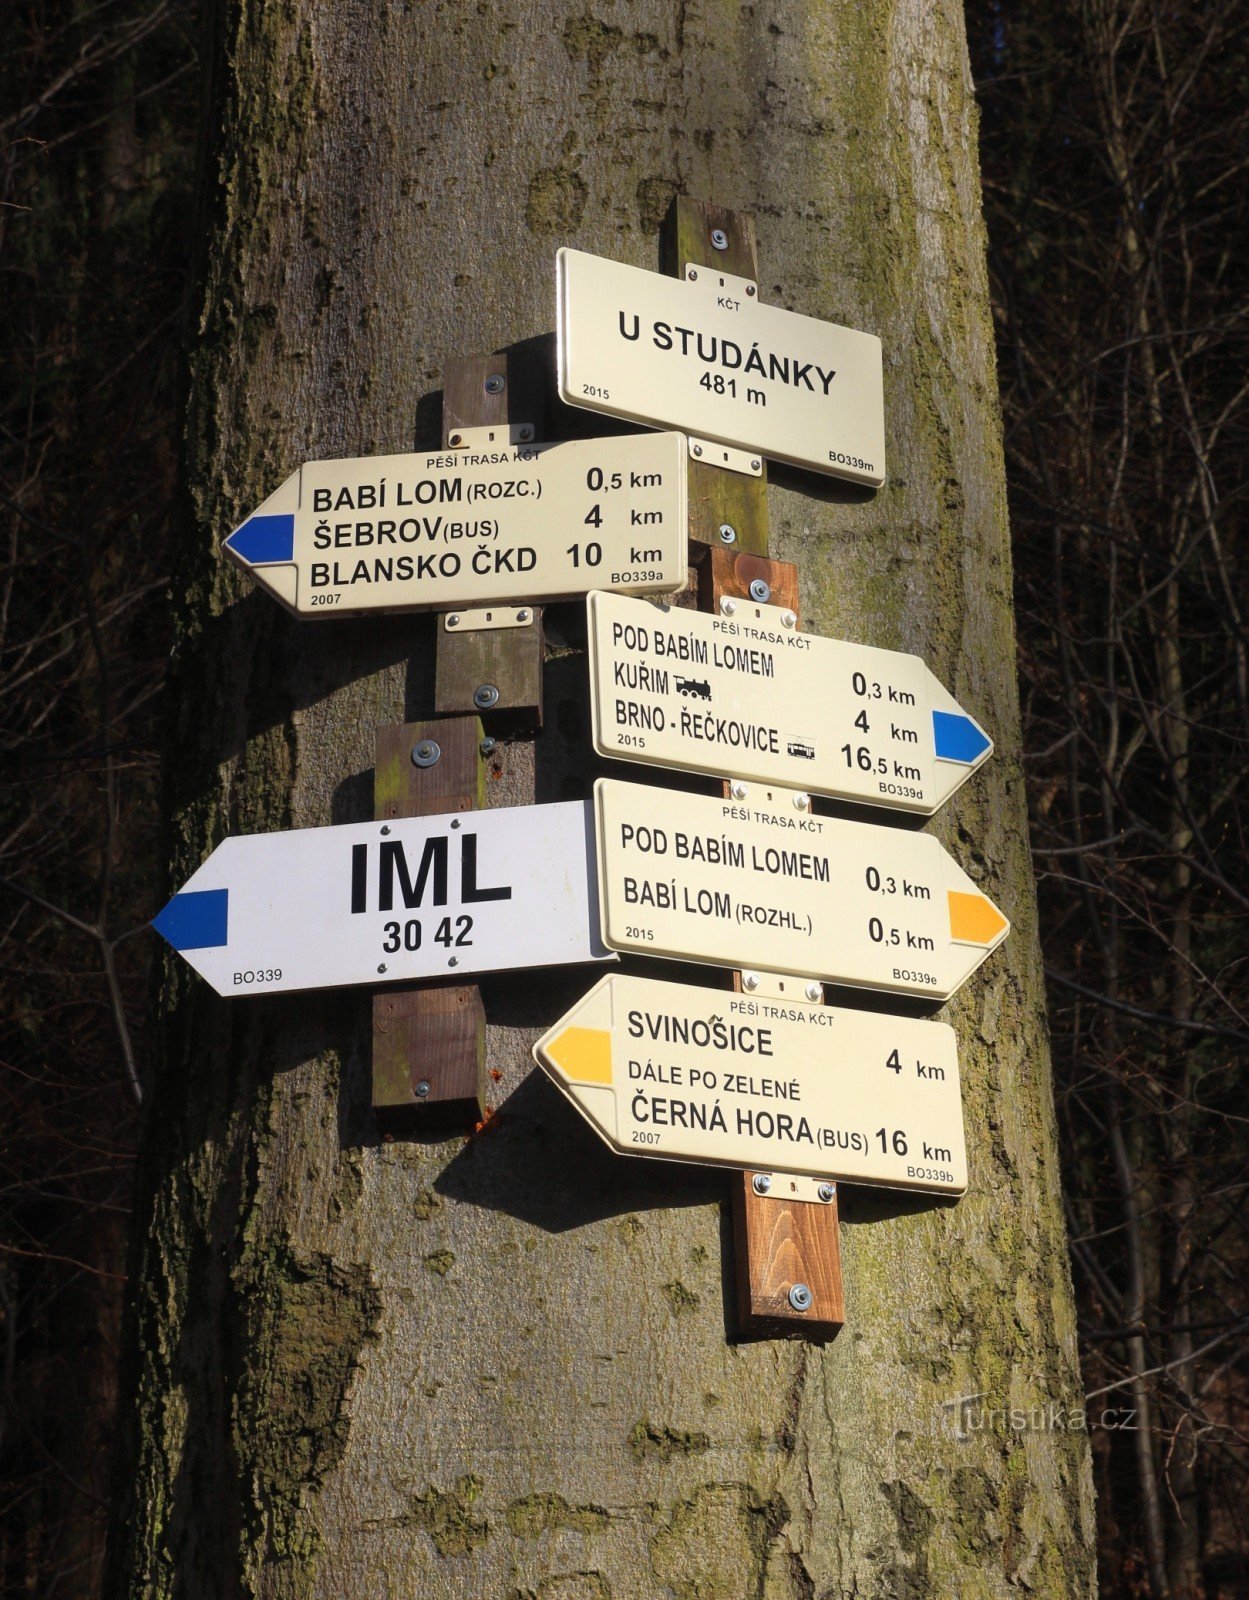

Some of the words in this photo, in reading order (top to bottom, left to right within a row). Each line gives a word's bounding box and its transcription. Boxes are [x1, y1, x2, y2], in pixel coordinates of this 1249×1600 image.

[717, 297, 740, 311] KČT
[619, 311, 639, 341] U
[653, 322, 836, 396] STUDÁNKY
[583, 384, 609, 400] 2015
[699, 372, 736, 398] 481
[747, 388, 766, 406] m
[427, 455, 457, 469] PĚŠÍ
[462, 453, 509, 466] TRASA
[513, 450, 540, 461] KČT
[829, 451, 874, 472] BO339m
[313, 478, 386, 513] BABÍ
[587, 467, 622, 493] 0,5
[630, 472, 662, 488] km
[584, 504, 603, 528] 4
[631, 509, 662, 525] km
[311, 553, 461, 587] BLANSKO
[472, 544, 537, 575] ČKD
[567, 542, 602, 568] 10
[630, 547, 662, 563] km
[611, 570, 663, 583] BO339a
[311, 594, 341, 606] 2007
[713, 621, 740, 636] PĚŠÍ
[743, 627, 784, 645] TRASA
[787, 637, 811, 650] KČT
[613, 622, 648, 652] POD
[654, 631, 708, 664] BABÍM
[713, 643, 774, 678] LOMEM
[852, 672, 882, 700] 0,3
[888, 686, 915, 706] km
[614, 660, 669, 695] KUŘIM
[854, 710, 870, 734] 4
[891, 723, 918, 743] km
[616, 699, 665, 732] BRNO
[681, 706, 779, 754] ŘEČKOVICE
[841, 744, 887, 775] 16,5
[894, 760, 921, 781] km
[617, 733, 645, 748] 2015
[879, 782, 923, 799] BO339d
[722, 806, 750, 821] PĚŠÍ
[754, 812, 796, 829] TRASA
[799, 820, 823, 833] KČT
[351, 833, 512, 914] IML
[621, 823, 667, 854] POD
[675, 832, 745, 868] BABÍM
[752, 846, 830, 882] LOMEM
[866, 866, 896, 895] 0,3
[903, 879, 930, 900] km
[624, 877, 676, 910] BABÍ
[869, 917, 900, 947] 0,5
[906, 931, 934, 951] km
[383, 919, 422, 953] 30
[434, 915, 473, 948] 42
[626, 926, 654, 941] 2015
[233, 968, 282, 985] BO339
[893, 968, 937, 985] BO339e
[730, 1001, 759, 1016] PĚŠÍ
[762, 1006, 806, 1023] TRASA
[809, 1013, 834, 1026] KČT
[628, 1010, 774, 1056] SVINOŠICE
[886, 1049, 902, 1074] 4
[917, 1060, 945, 1081] km
[629, 1059, 682, 1085] DÁLE
[690, 1069, 717, 1089] PO
[723, 1073, 801, 1101] ZELENÉ
[631, 1089, 728, 1133] ČERNÁ
[876, 1128, 908, 1156] 16
[923, 1142, 951, 1162] km
[632, 1131, 660, 1144] 2007
[907, 1166, 953, 1182] BO339b
